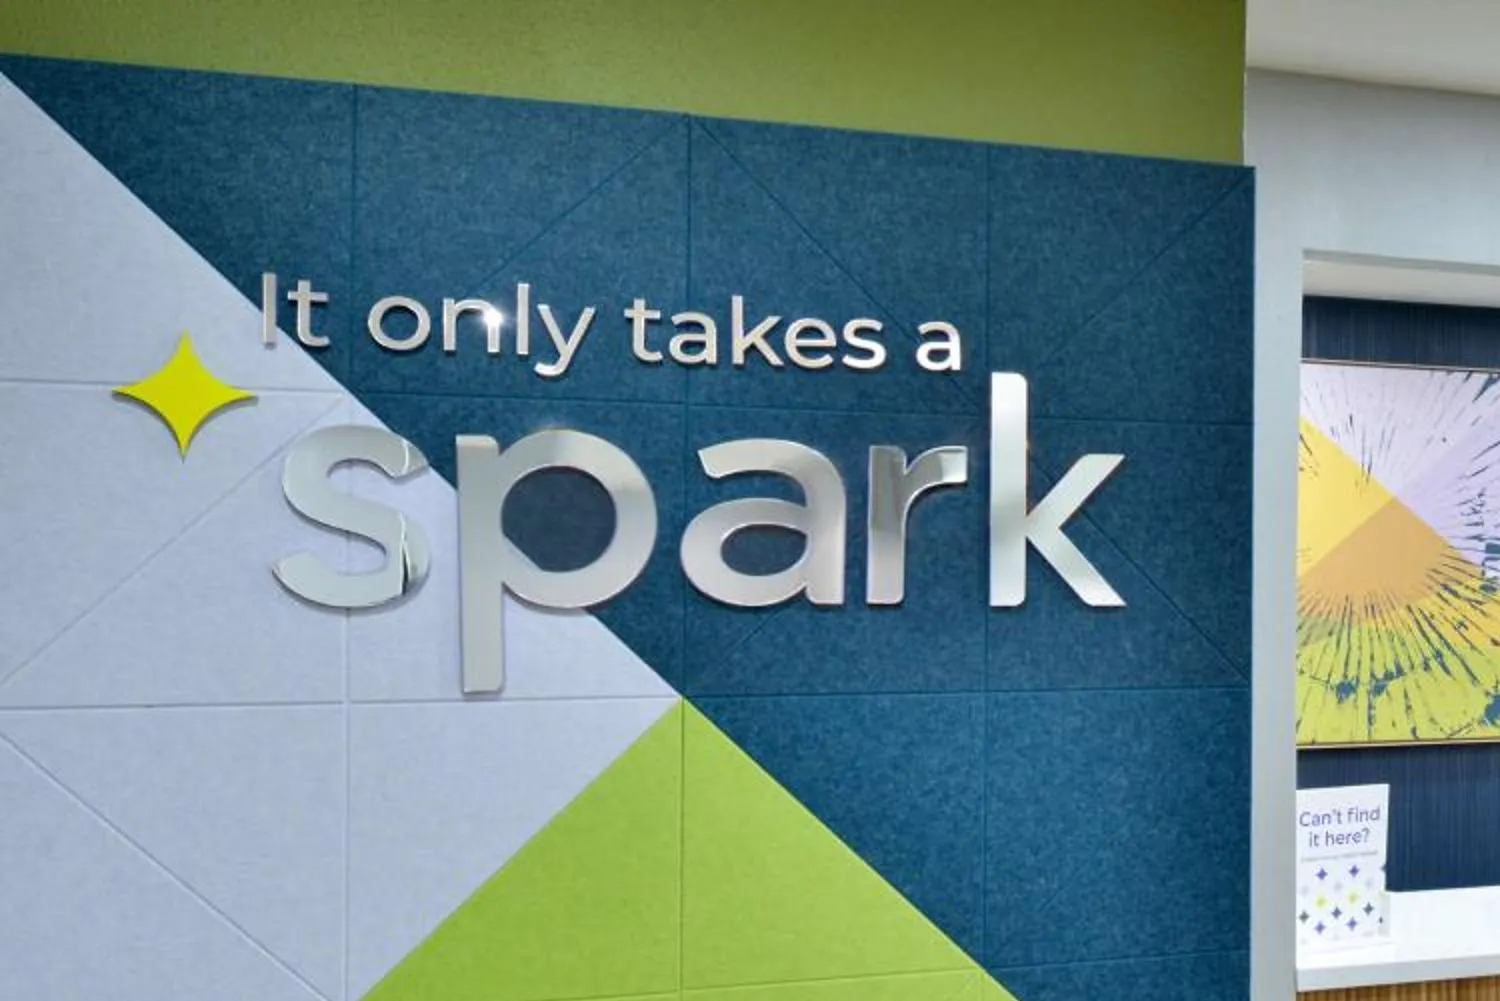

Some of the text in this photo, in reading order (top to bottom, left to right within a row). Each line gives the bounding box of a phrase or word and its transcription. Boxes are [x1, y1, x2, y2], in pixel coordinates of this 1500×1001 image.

[262, 272, 962, 377] It only takes a
[271, 371, 1128, 695] spark
[1299, 806, 1380, 827] Can't find
[1308, 828, 1371, 848] it here?
